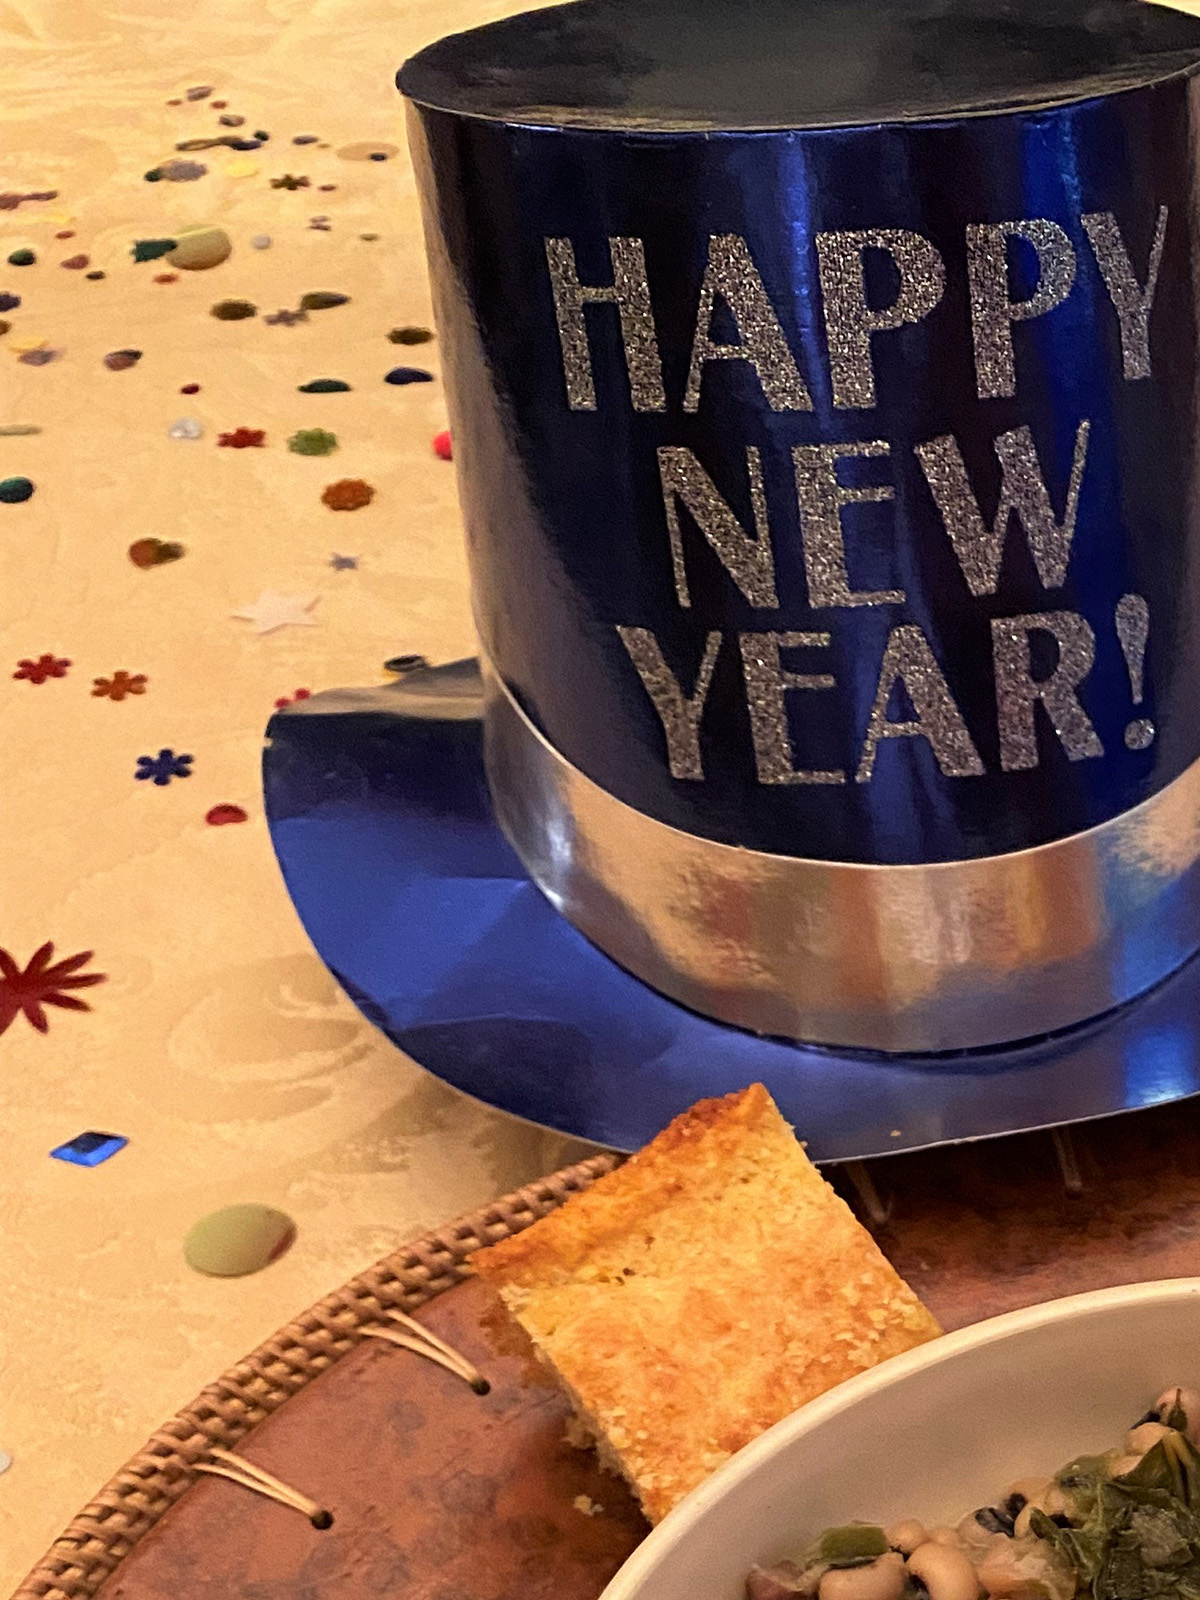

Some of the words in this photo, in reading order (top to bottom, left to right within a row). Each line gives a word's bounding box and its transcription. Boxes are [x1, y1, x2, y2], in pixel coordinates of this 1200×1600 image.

[543, 205, 1169, 414] HAPPY
[656, 418, 1091, 609] NEW
[615, 593, 1156, 786] YEAR!
